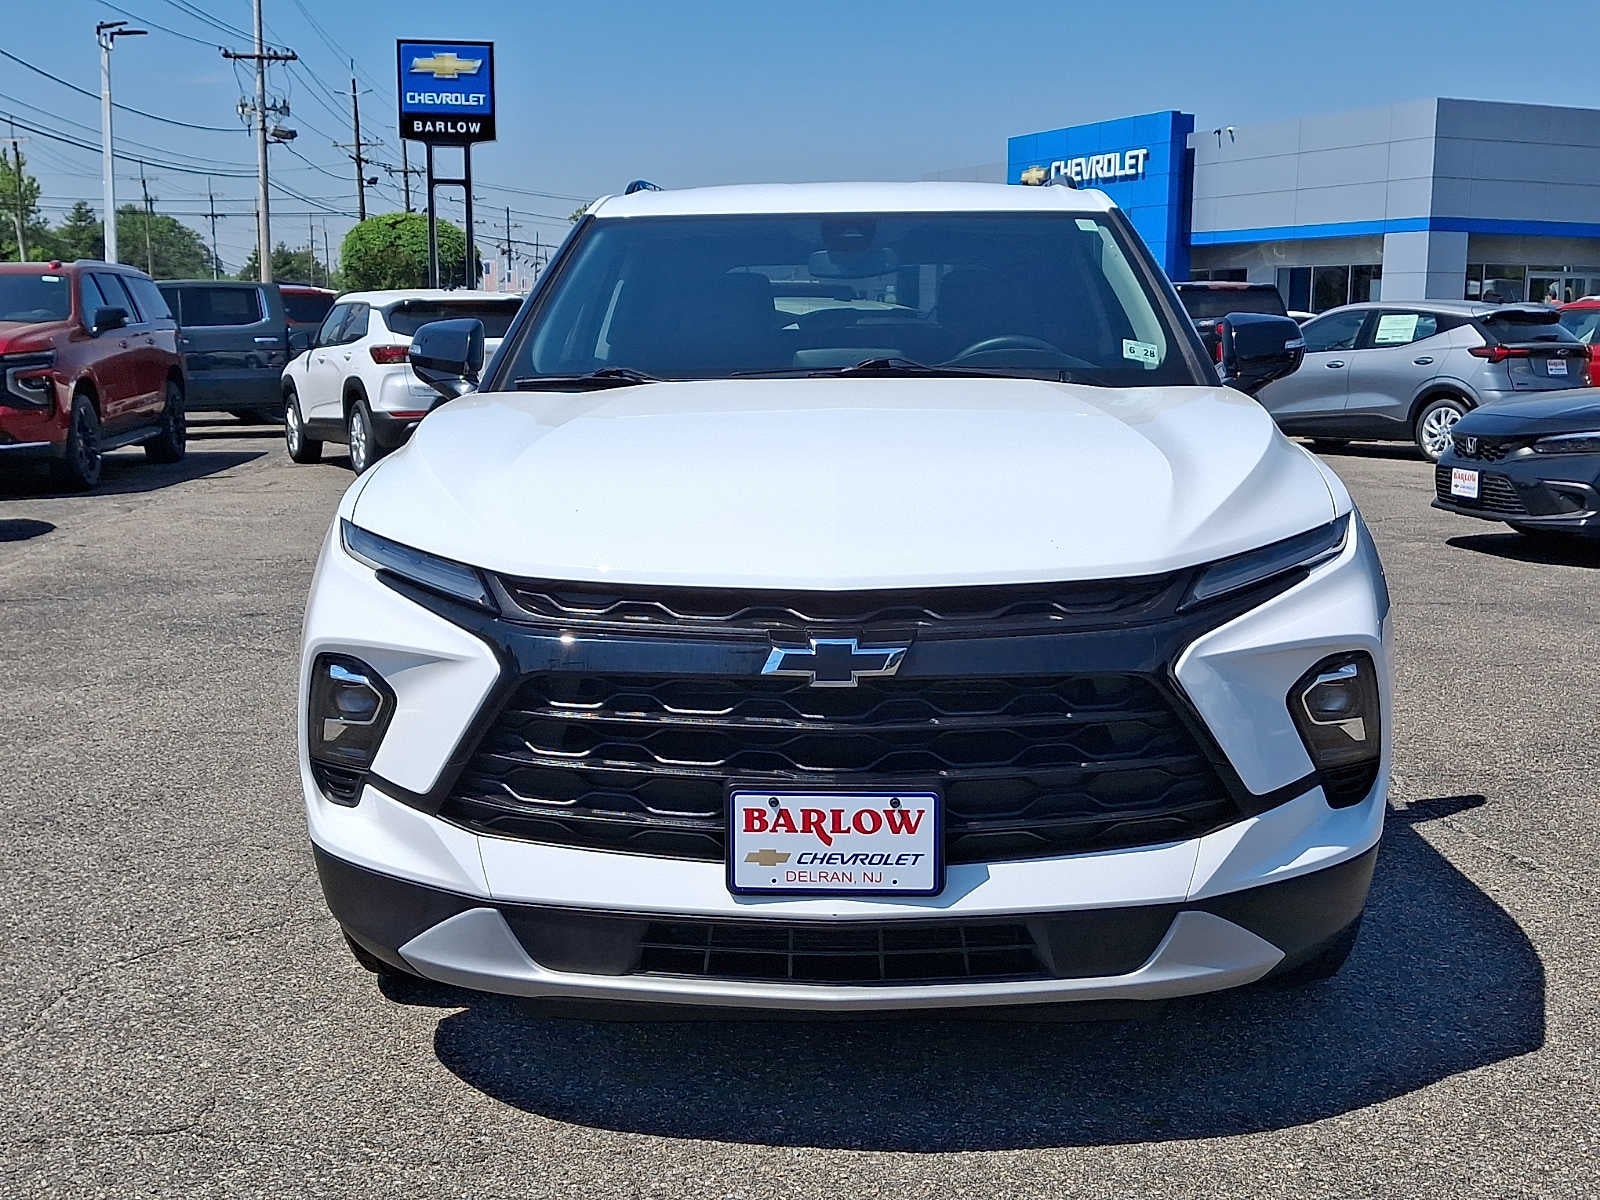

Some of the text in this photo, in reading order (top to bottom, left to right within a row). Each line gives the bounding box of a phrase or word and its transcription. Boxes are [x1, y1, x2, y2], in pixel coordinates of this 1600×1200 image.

[406, 92, 486, 105] CHEVROLET
[413, 120, 481, 133] BARLOW
[1050, 148, 1147, 181] CHEVROLET
[1129, 346, 1136, 354] 6
[742, 807, 926, 847] BARLOW
[796, 852, 925, 866] CHEVROLET
[785, 870, 883, 885] DELRAN, NJ
